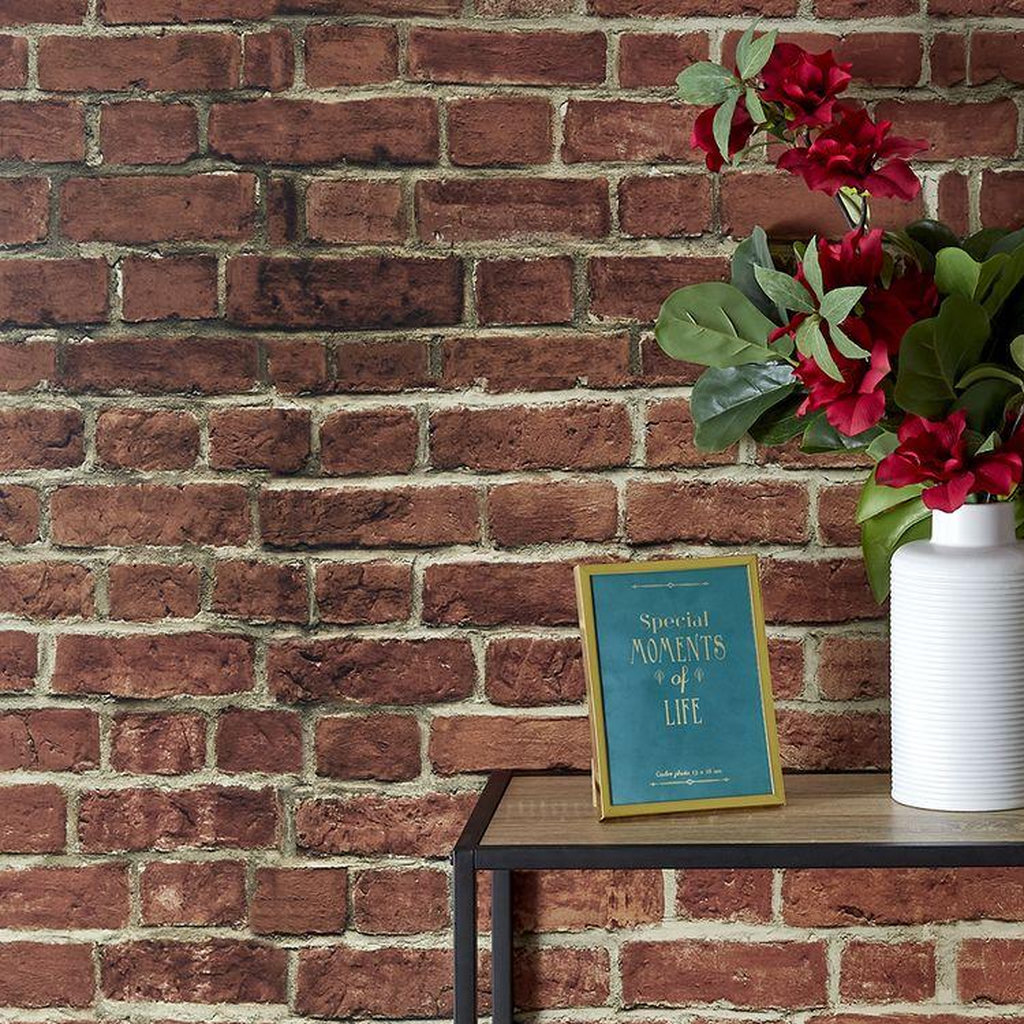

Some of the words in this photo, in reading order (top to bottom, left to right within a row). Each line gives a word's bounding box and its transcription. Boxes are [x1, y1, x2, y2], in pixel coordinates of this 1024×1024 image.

[639, 611, 709, 634] Special
[630, 633, 726, 665] MOMENTS
[670, 665, 689, 694] of
[664, 698, 703, 726] LIFE
